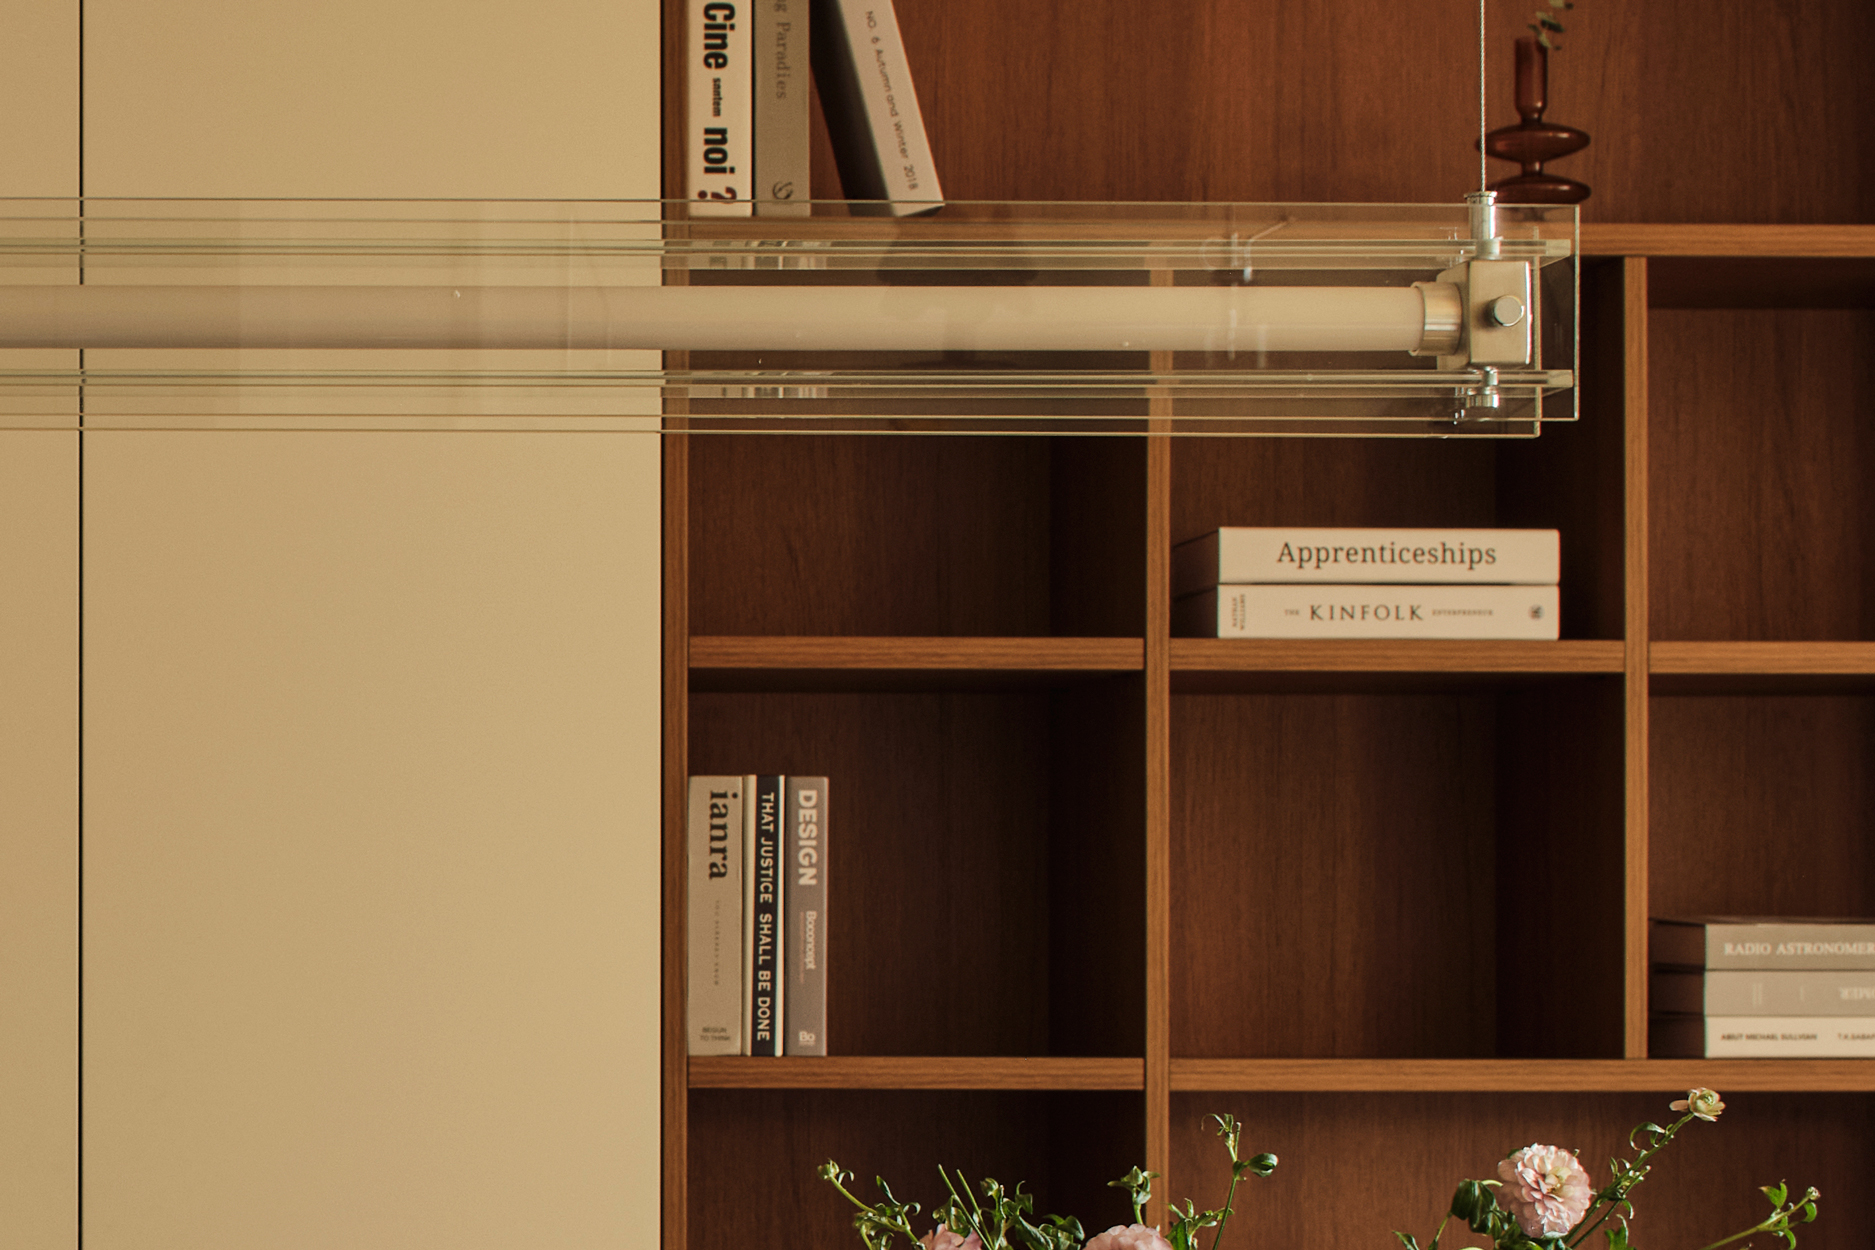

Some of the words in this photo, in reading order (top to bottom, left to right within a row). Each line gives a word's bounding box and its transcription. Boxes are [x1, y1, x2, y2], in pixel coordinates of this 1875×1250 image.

[703, 1, 735, 70] Cine
[776, 21, 792, 100] Paradies
[875, 49, 892, 93] Autumn
[886, 94, 898, 117] and
[894, 120, 910, 159] Winter
[904, 164, 919, 191] 2018
[703, 127, 735, 175] noi
[1276, 541, 1497, 570] Apprenticeships
[1309, 604, 1424, 621] KINFOLK
[708, 789, 739, 881] ianra
[761, 792, 775, 833] THAT
[798, 789, 818, 886] DESIGN
[759, 836, 774, 904] JUSTICE
[758, 912, 773, 966] SHALL
[1723, 942, 1772, 956] RADIO
[757, 969, 772, 992] BE
[756, 996, 771, 1042] DONE
